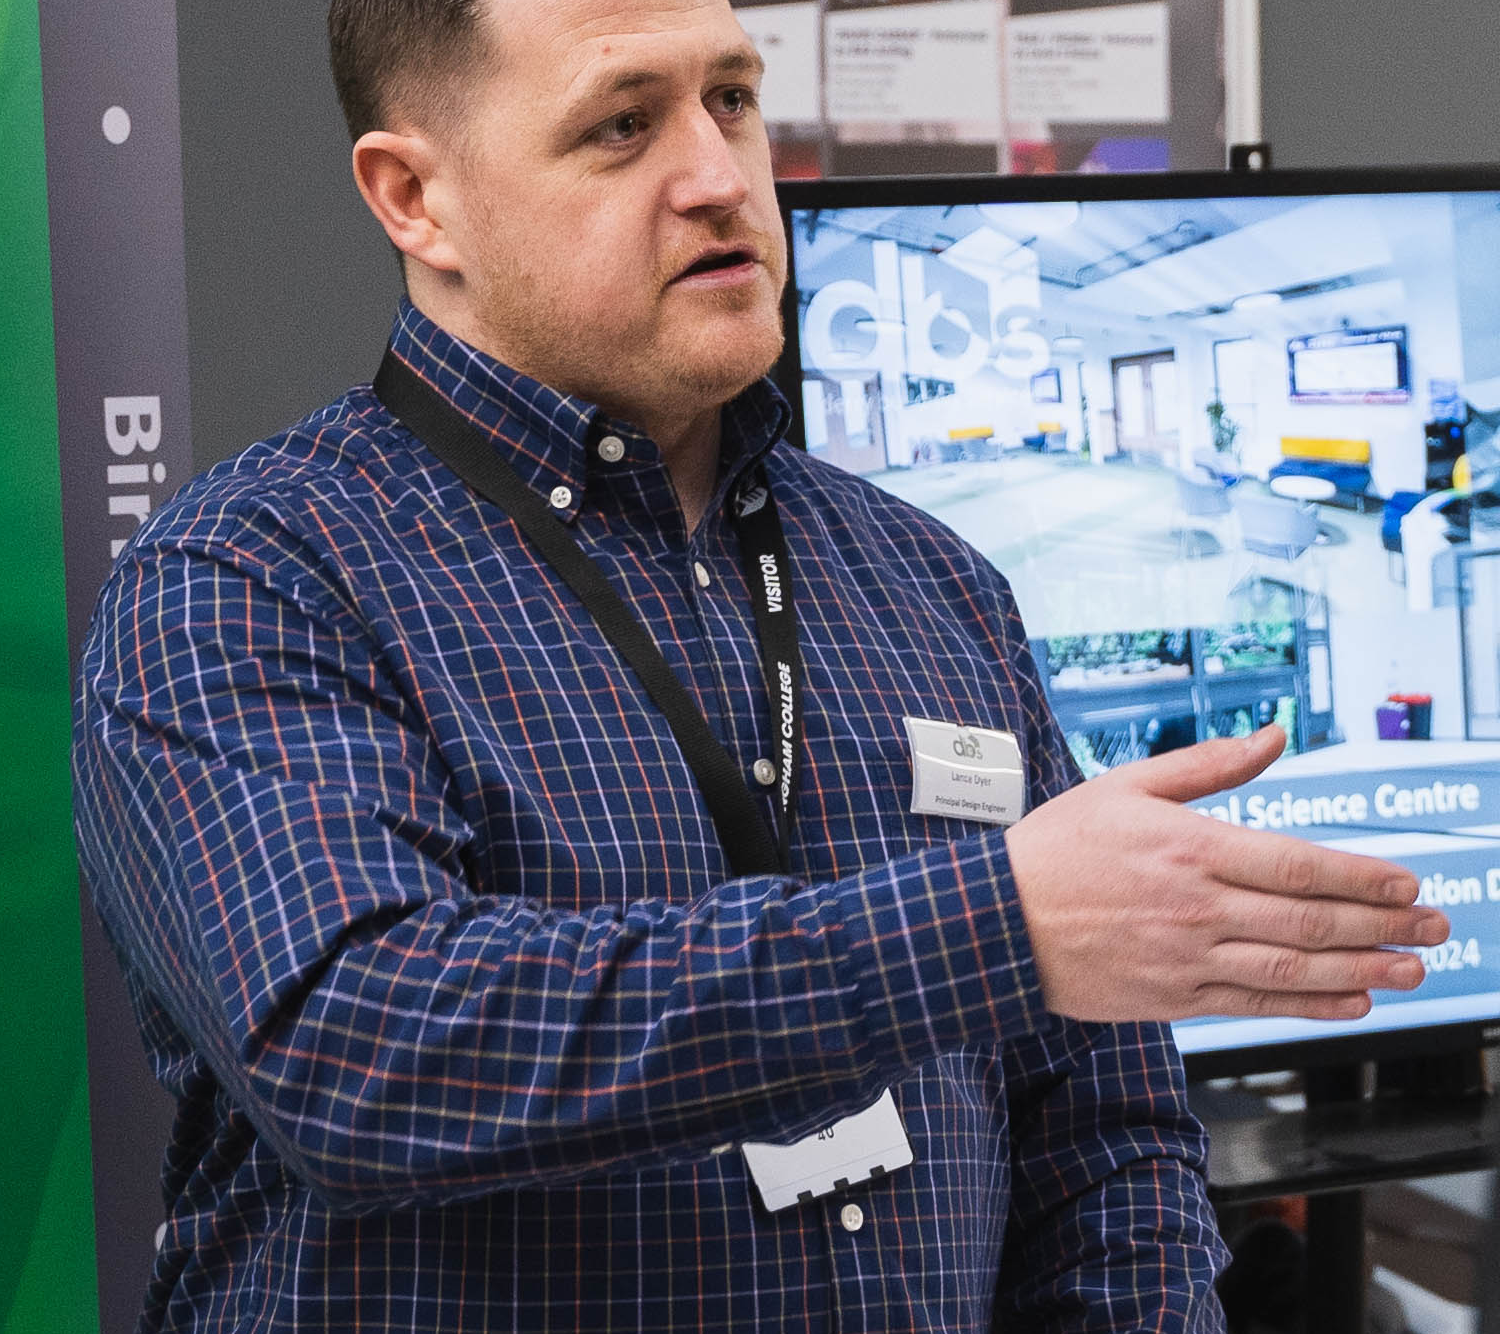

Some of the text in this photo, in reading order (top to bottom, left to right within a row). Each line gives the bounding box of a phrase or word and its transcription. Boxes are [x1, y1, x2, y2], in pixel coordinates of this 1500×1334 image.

[804, 227, 1051, 379] dbs
[104, 395, 167, 560] Bir
[759, 554, 783, 613] VISITOR
[777, 661, 794, 813] GHAM COLLEGE
[961, 799, 981, 812] Design
[982, 802, 1006, 814] Engineer
[1246, 792, 1368, 828] Science
[1374, 781, 1481, 818] Centre
[1418, 874, 1482, 907] tion
